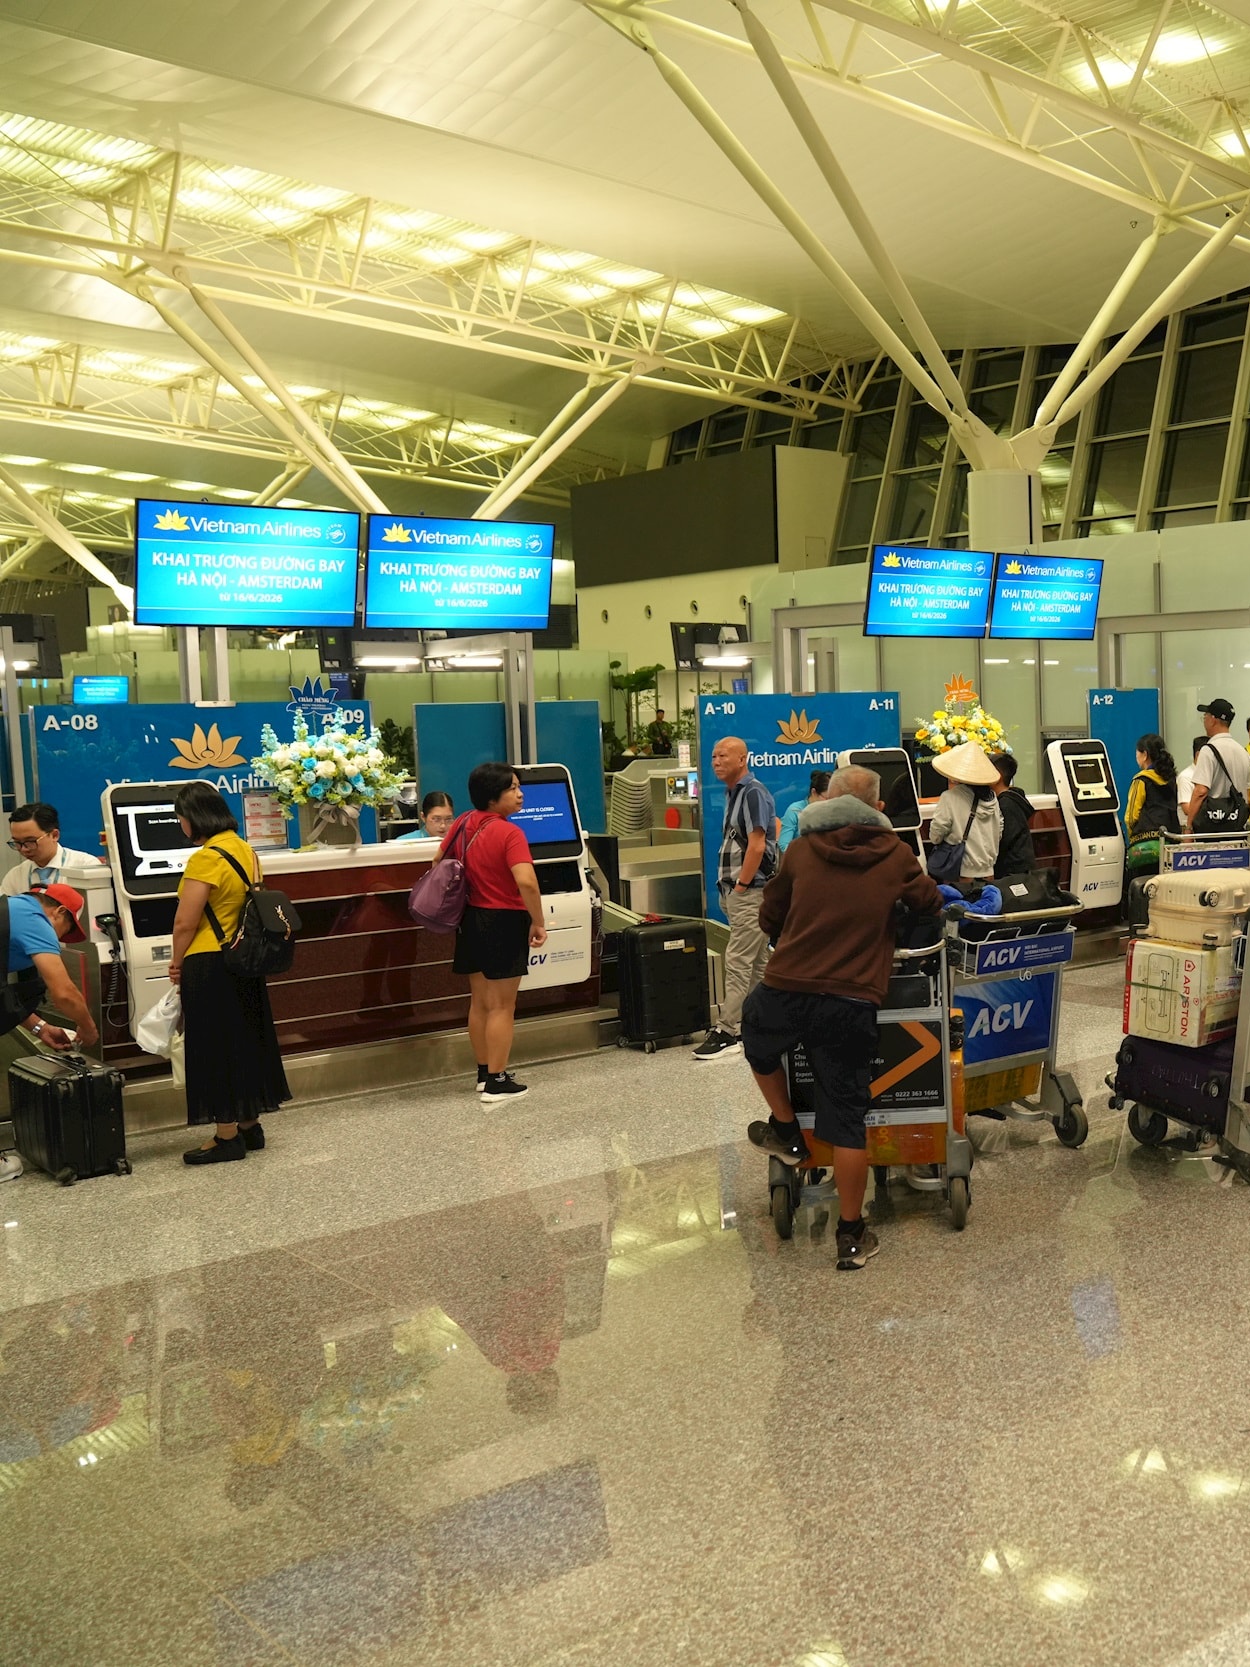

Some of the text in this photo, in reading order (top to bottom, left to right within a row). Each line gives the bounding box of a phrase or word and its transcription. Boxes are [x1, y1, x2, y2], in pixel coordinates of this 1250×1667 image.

[190, 516, 322, 538] Vietnam Airlines
[412, 529, 522, 548] Vietnam Airlines
[152, 552, 345, 573] KHAI TRƯƠNG ĐƯỜNG BAY
[901, 556, 973, 571] Vietnam Airlines
[380, 562, 541, 579] KHAI TRƯƠNG ĐƯỜNG BAY
[1021, 564, 1084, 578] Vietnam Airlines
[176, 570, 198, 585] HÀ
[201, 571, 227, 589] NỘI
[238, 575, 323, 590] AMSTERDAM
[400, 579, 417, 593] HÀ
[420, 580, 442, 596] NỘI
[451, 583, 522, 595] AMSTERDAM
[878, 583, 984, 597] KHAI TRƯƠNG ĐƯỜNG BAY
[1001, 589, 1093, 602] KHAI TRƯƠNG ĐƯỜNG BAY
[233, 593, 283, 603] 16/6/2026
[447, 599, 489, 608] 16/6/2026
[890, 596, 902, 607] HÀ
[903, 596, 918, 609] NỘI
[922, 600, 970, 610] AMSTERDAM
[1011, 601, 1022, 611] HÀ
[1022, 601, 1036, 614] NỘI
[1040, 604, 1081, 613] AMSTERDAM
[869, 698, 894, 711] A-11
[1093, 694, 1114, 705] A-12
[704, 702, 736, 715] A-10
[43, 714, 98, 731] A-08
[321, 709, 365, 725] A09
[802, 748, 840, 765] Airlin
[216, 774, 279, 794] Airlin
[1177, 855, 1207, 867] ACV
[1083, 882, 1099, 892] ACV
[527, 954, 547, 967] CV
[983, 947, 1021, 968] ACV
[1180, 975, 1191, 1037] ARSTON
[968, 1000, 1034, 1038] ACV
